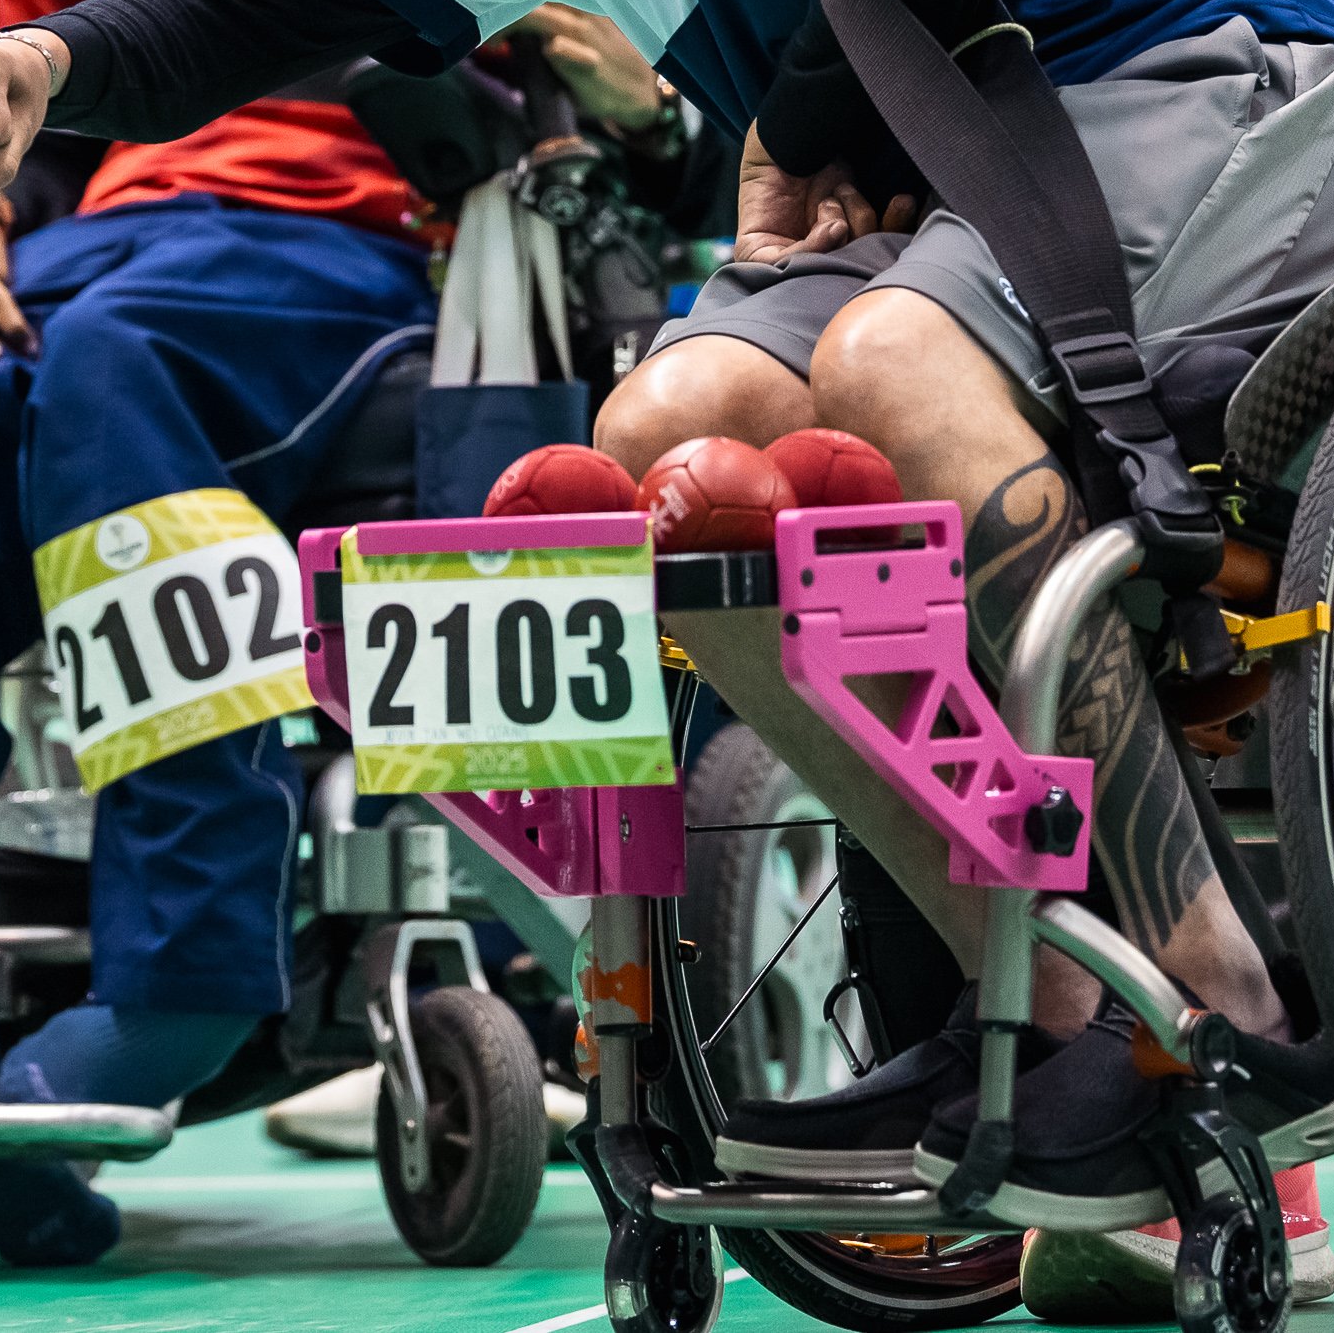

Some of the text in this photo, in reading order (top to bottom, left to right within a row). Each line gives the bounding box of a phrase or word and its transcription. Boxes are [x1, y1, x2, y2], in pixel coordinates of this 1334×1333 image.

[57, 556, 303, 734] 2102
[367, 598, 632, 727] 2103
[464, 747, 529, 775] 2025
